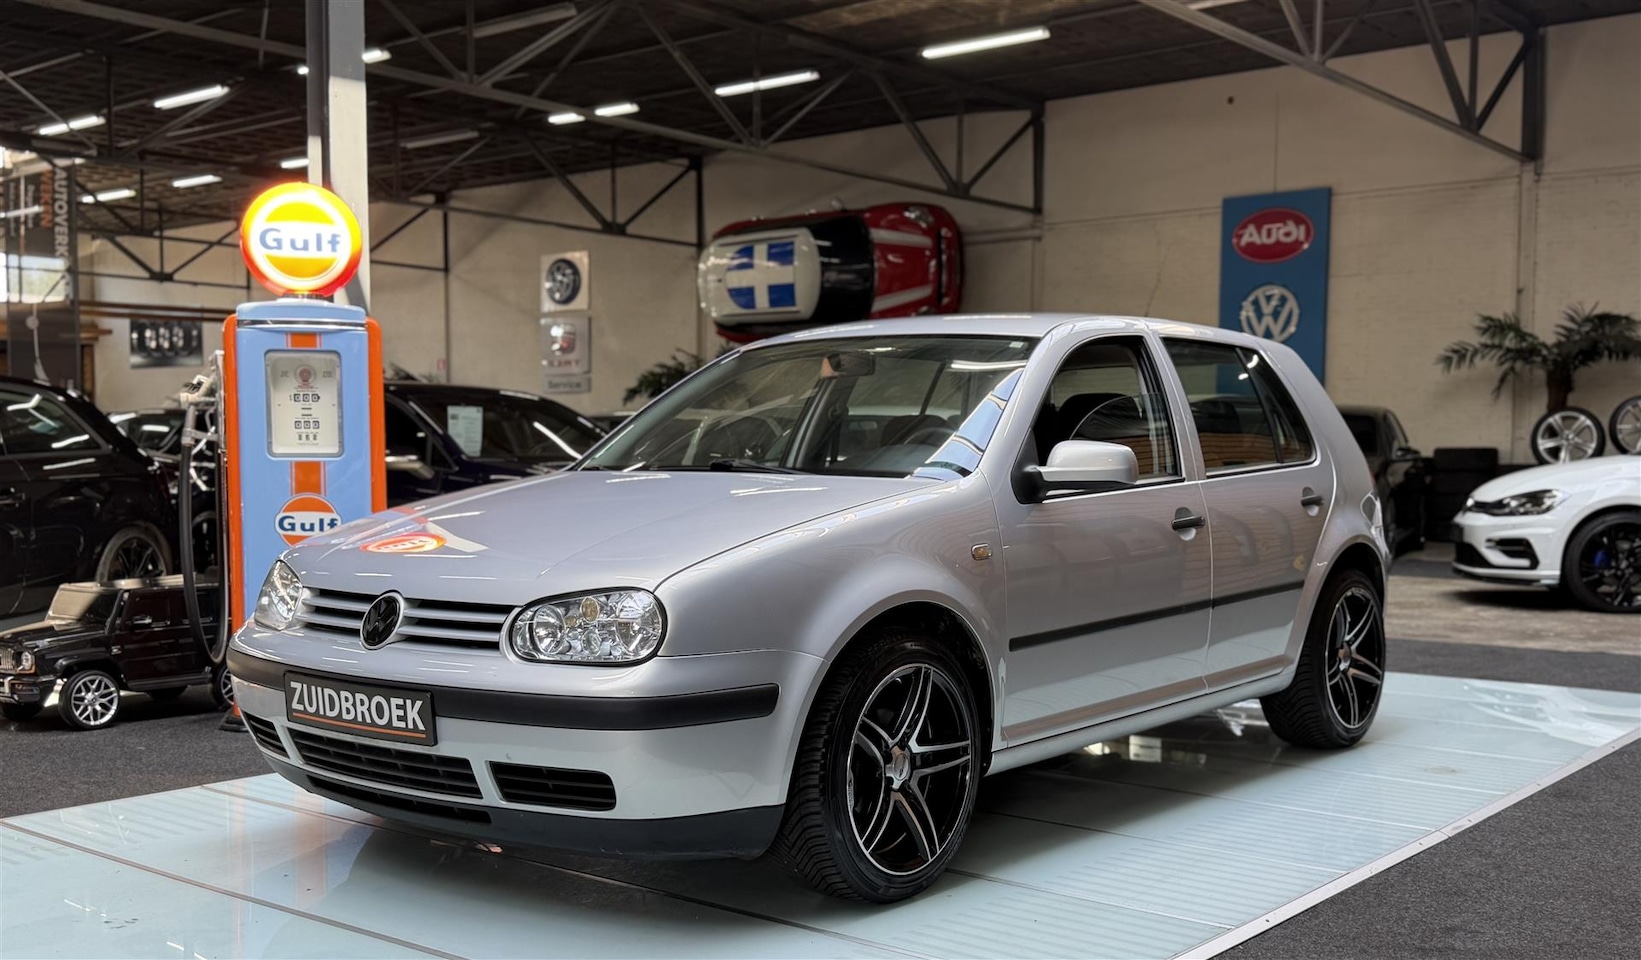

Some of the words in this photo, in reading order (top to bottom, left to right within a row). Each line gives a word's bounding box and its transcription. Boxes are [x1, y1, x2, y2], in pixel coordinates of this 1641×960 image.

[259, 228, 341, 253] Gulf
[278, 515, 339, 533] Gulf
[290, 681, 426, 731] ZUIDBROEK
